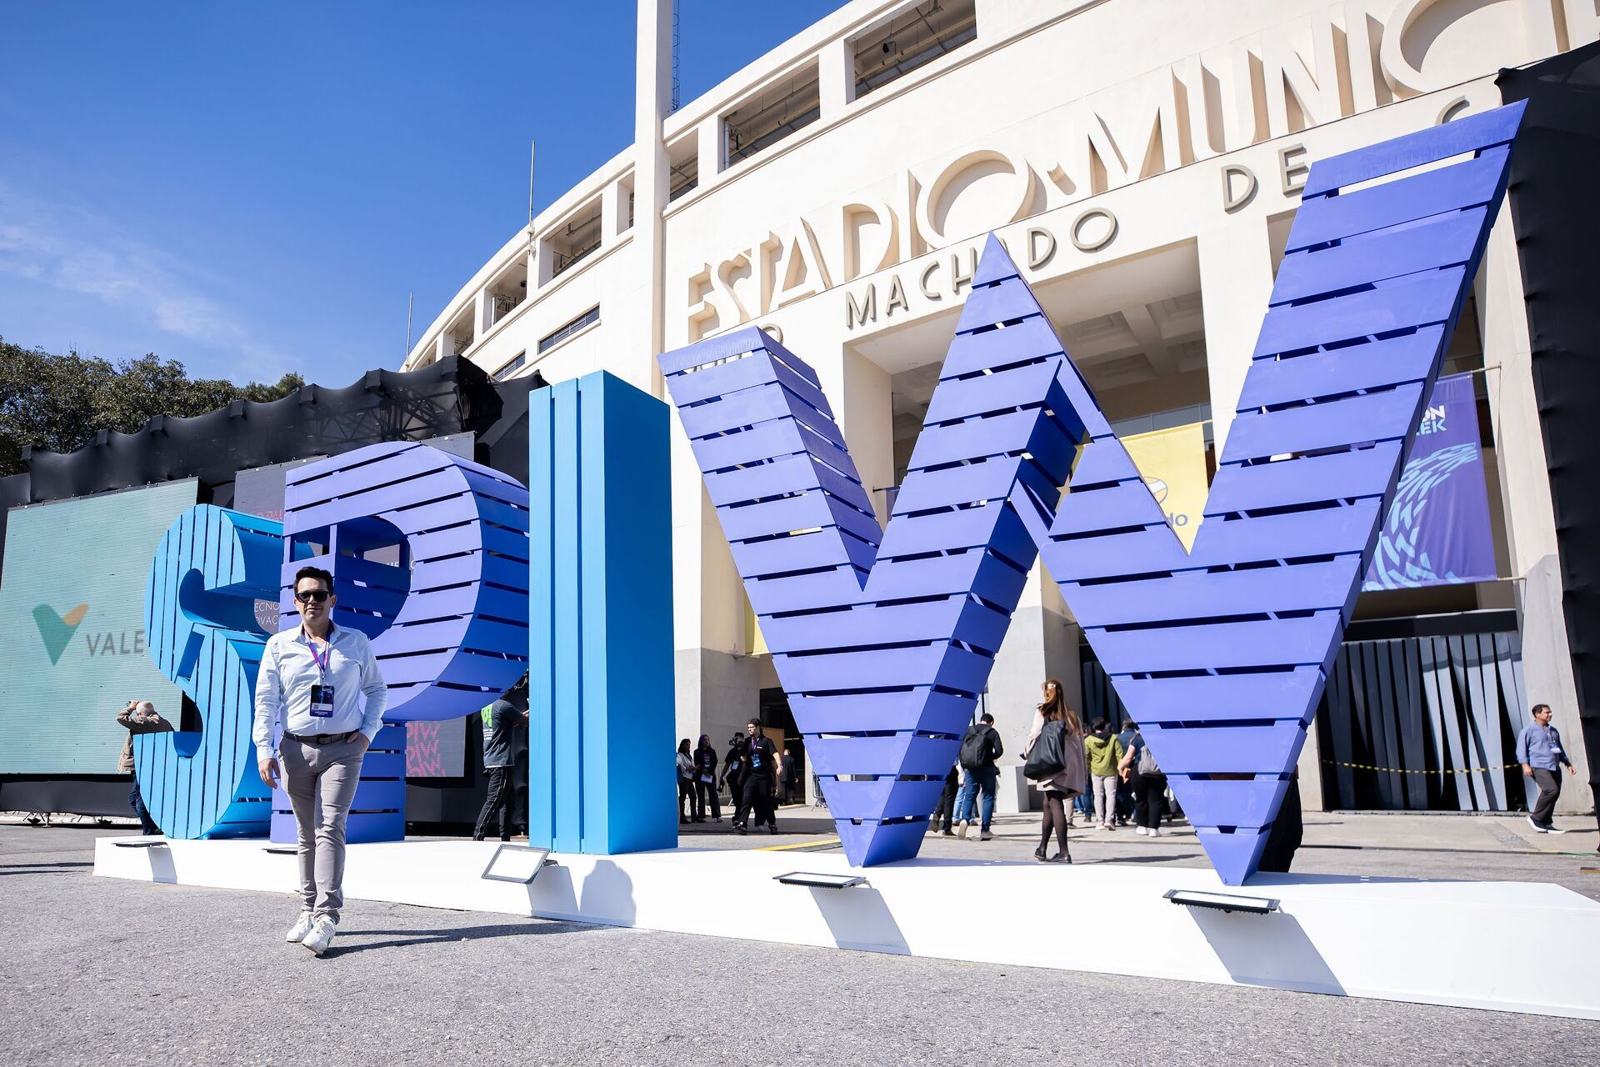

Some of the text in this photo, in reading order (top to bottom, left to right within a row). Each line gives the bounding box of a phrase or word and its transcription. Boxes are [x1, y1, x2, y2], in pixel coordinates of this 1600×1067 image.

[845, 142, 1310, 328] MACHDO DE
[1416, 419, 1447, 435] EK
[86, 631, 145, 656] VALE
